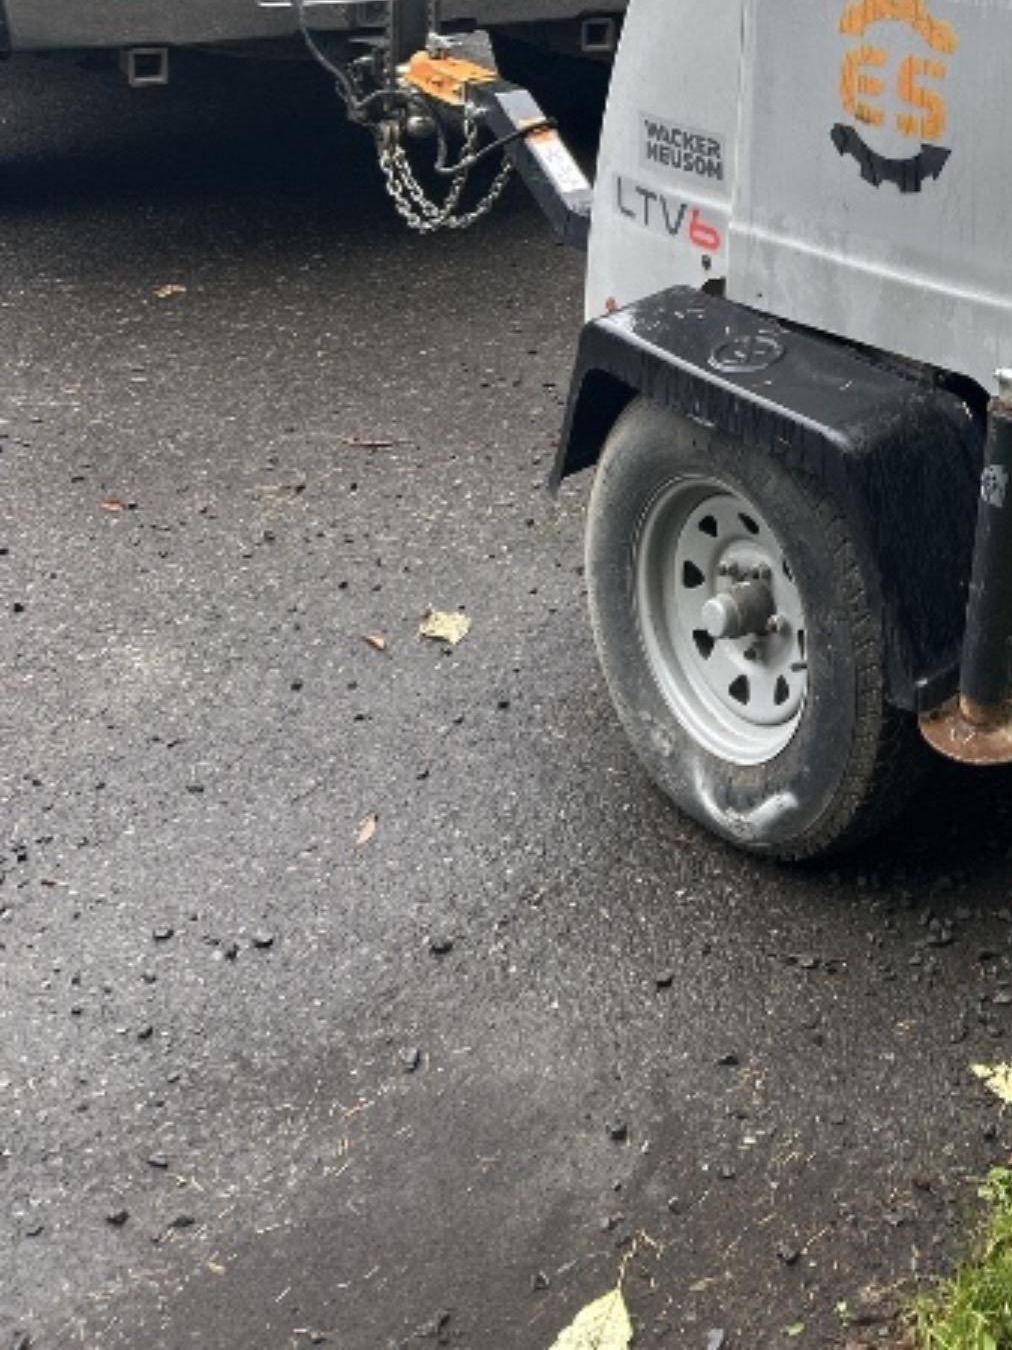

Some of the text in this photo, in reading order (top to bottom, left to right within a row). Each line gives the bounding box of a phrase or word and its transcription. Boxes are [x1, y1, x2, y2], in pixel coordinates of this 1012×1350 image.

[840, 46, 946, 140] ES
[644, 119, 721, 160] WACKER
[646, 141, 723, 181] NEUSON
[617, 176, 721, 252] LTV6
